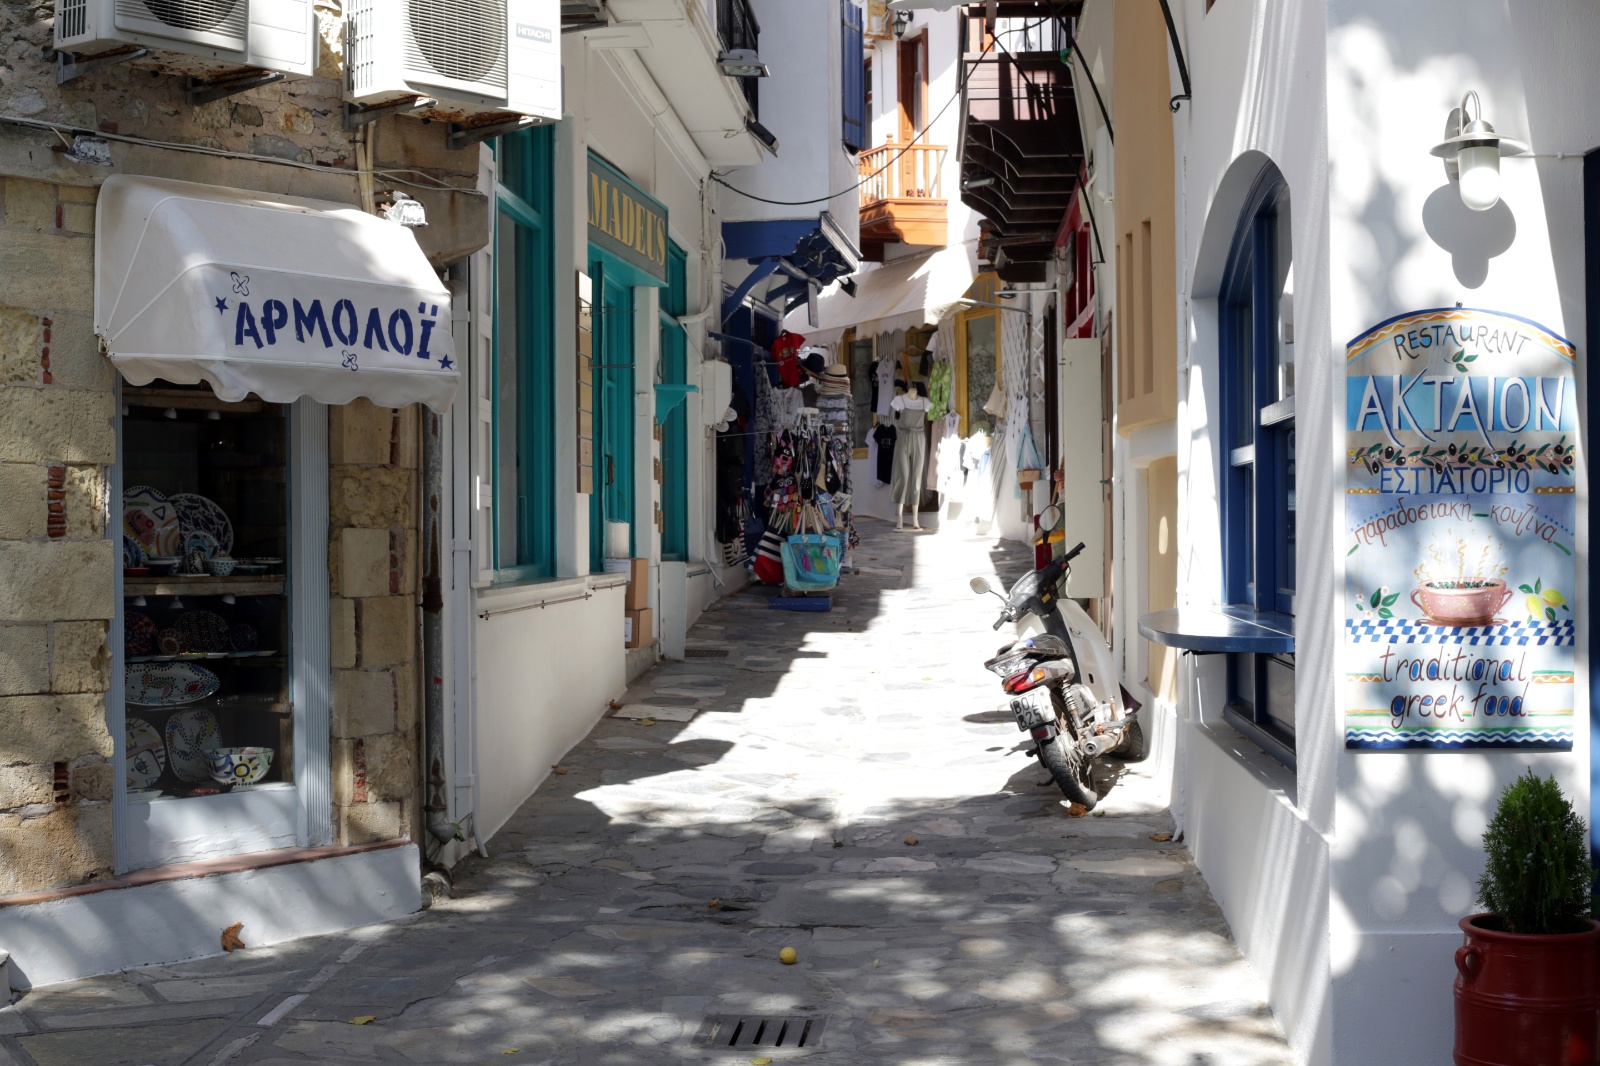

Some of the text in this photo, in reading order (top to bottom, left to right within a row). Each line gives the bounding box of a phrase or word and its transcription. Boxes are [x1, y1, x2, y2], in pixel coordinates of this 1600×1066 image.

[517, 26, 551, 40] HITACHI
[587, 171, 665, 266] MADEUS
[1380, 466, 1530, 495] ΕΣΤΙΑΤΟΡΙΟ
[1379, 645, 1527, 685] traditional
[1390, 682, 1530, 729] greek food
